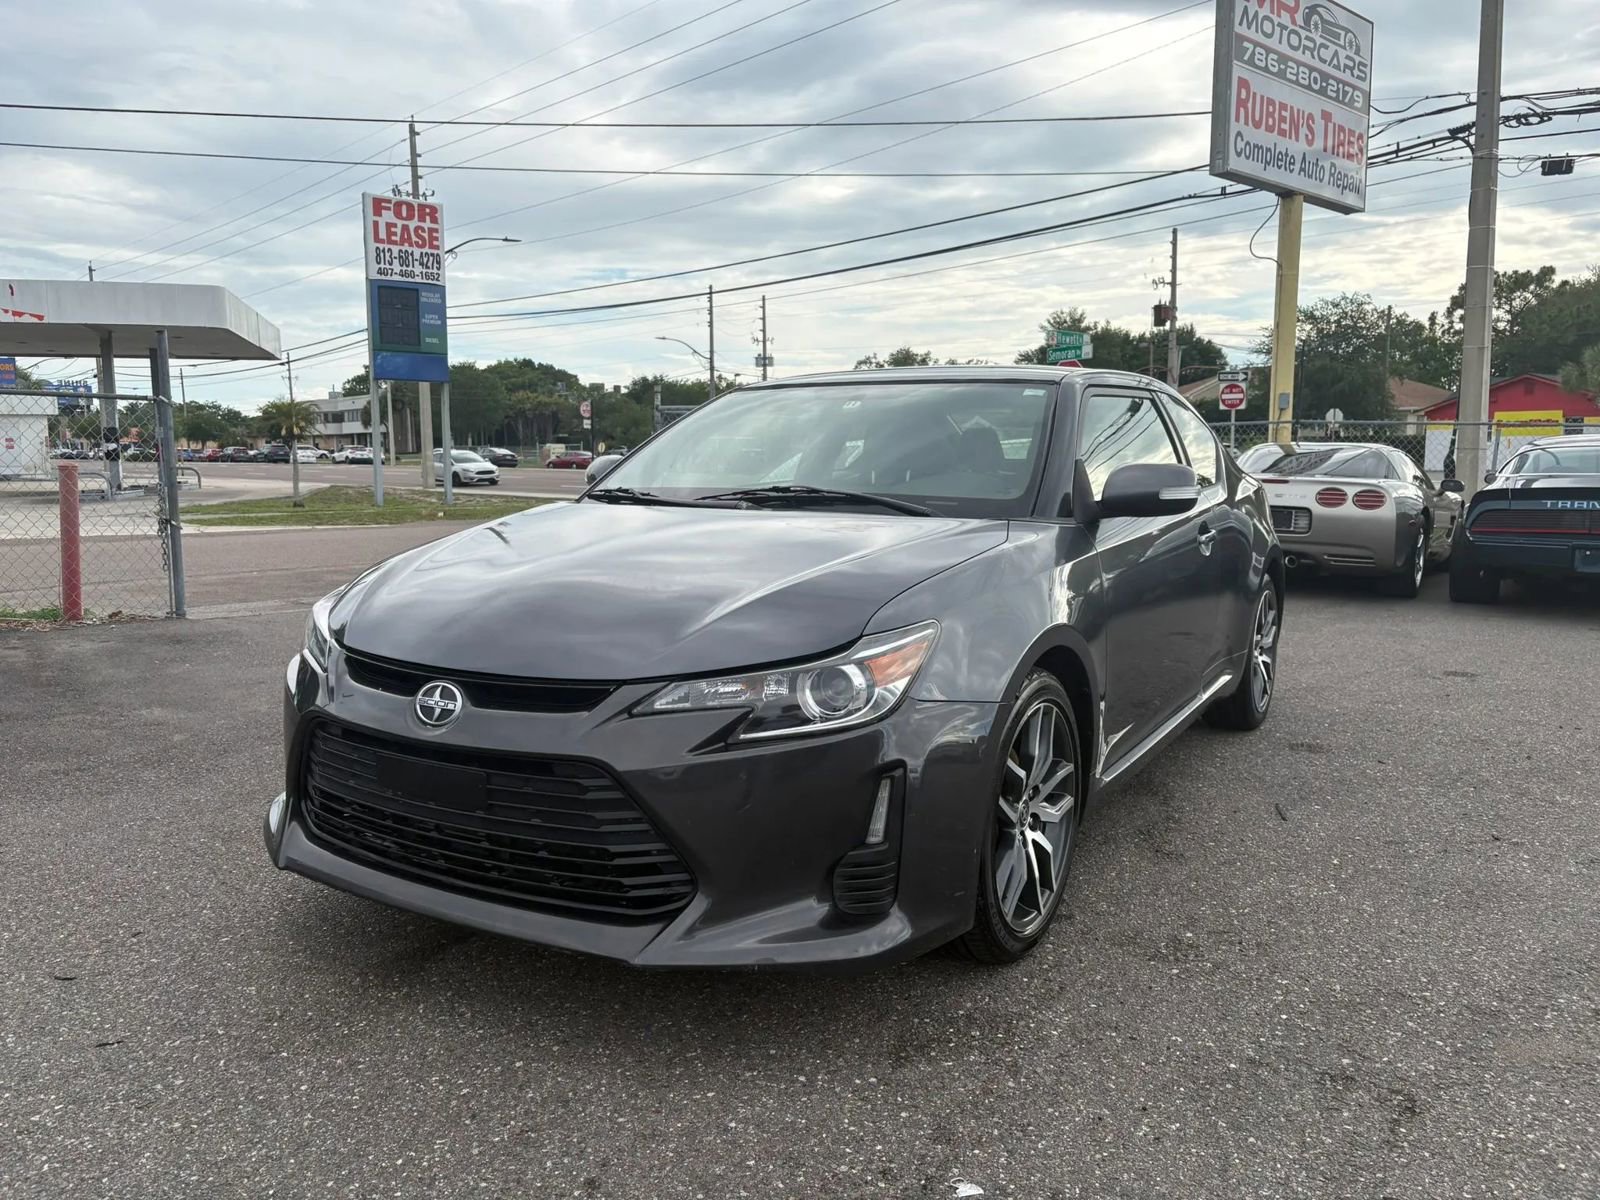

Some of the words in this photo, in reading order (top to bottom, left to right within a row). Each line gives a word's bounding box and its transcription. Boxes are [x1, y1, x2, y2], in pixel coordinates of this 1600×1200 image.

[1238, 5, 1369, 83] MOTORCARS
[1242, 41, 1363, 108] 786-280-2179
[1234, 75, 1316, 147] RUBEN'S
[1321, 108, 1365, 166] TIRES
[1233, 130, 1296, 171] Complete
[1298, 152, 1324, 183] Auto
[1328, 162, 1363, 195] Repair
[372, 196, 439, 225] FOR
[372, 220, 440, 250] LEASE
[375, 246, 441, 271] 813-681-4279
[376, 266, 441, 281] 407-460-1652
[1048, 349, 1076, 361] Semoran
[418, 697, 457, 709] SCION
